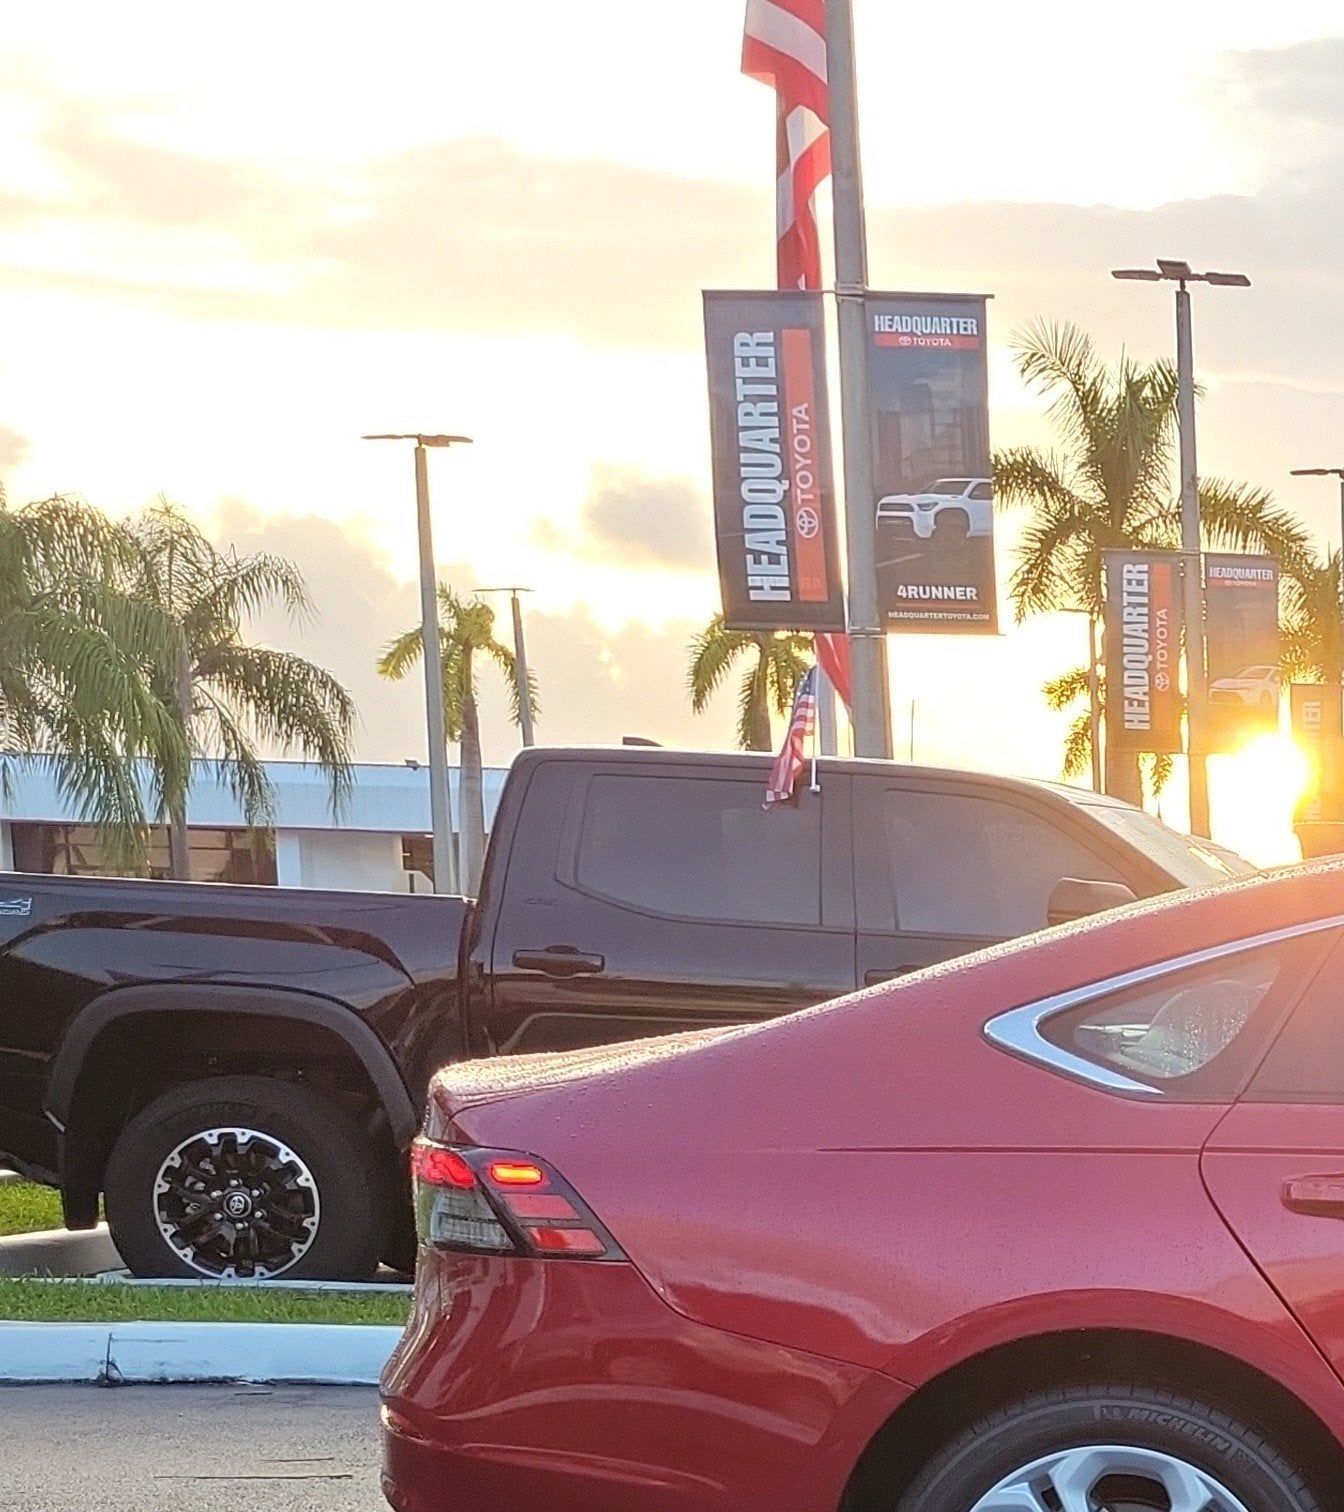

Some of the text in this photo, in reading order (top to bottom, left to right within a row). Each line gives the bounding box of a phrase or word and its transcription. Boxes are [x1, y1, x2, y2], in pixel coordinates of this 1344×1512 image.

[874, 314, 978, 336] HEADQUARTER
[912, 337, 952, 346] TOYOTA
[733, 331, 791, 601] HEADQUARTER
[791, 402, 814, 505] TOYOTA
[1209, 566, 1274, 581] HEADQUARTER
[896, 585, 978, 600] 4RUNNER
[888, 611, 990, 620] HEADQUARTERTOYOTA.COM
[1122, 563, 1153, 731] HEADQUARTER
[1156, 608, 1169, 671] TOYOTA
[1127, 1407, 1232, 1452] MICHELIN
